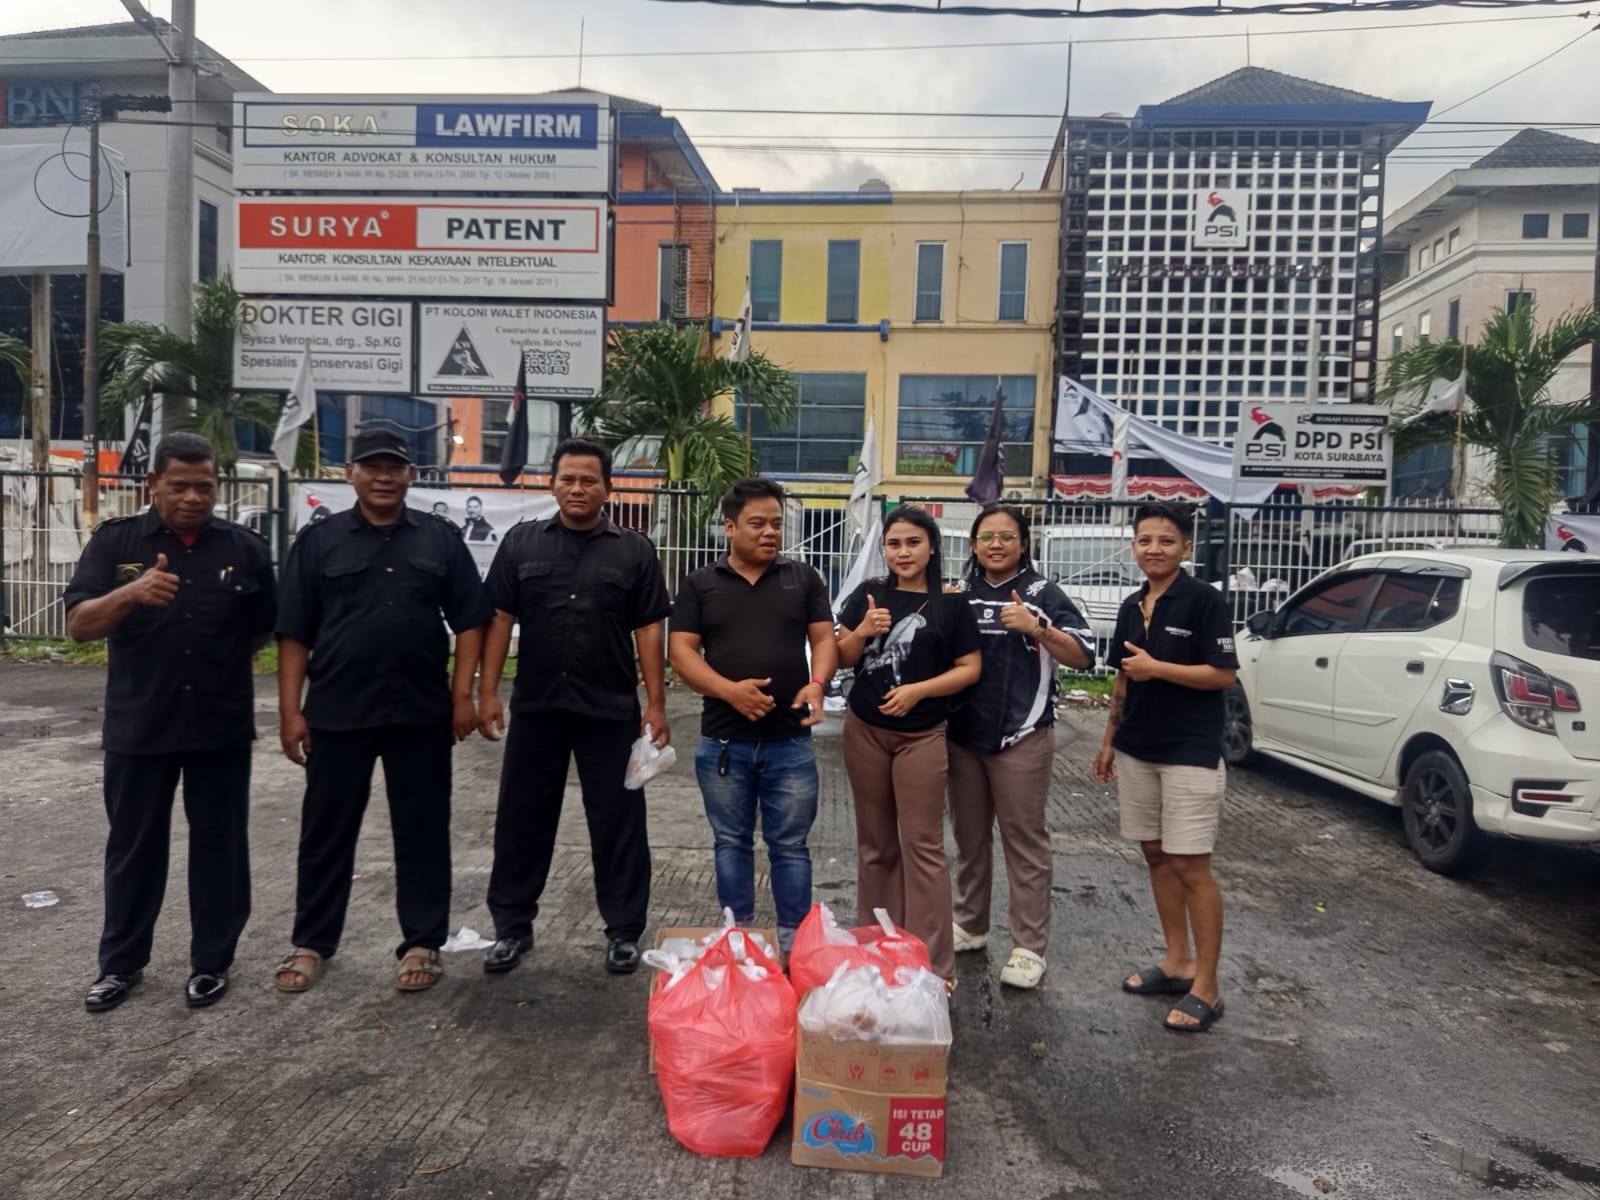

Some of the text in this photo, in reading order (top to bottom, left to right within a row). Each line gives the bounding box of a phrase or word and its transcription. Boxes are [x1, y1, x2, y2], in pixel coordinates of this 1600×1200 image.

[434, 113, 581, 138] LAWFIRM
[283, 152, 557, 165] KANTOR ADVOKAT & KONSULTAN HUKUM
[446, 218, 567, 241] PATENT
[1204, 226, 1238, 237] PSI
[278, 254, 557, 268] KANTOR KONSULTAN KEKAYAAN INTELEKTUAL
[242, 305, 403, 328] DOKTER GIGI
[426, 307, 597, 320] PT KOLONI WALET INDONESIA
[241, 334, 276, 346] Sysca
[241, 355, 403, 373] Spesialis onservasi Gigi
[1295, 431, 1383, 450] DPD PSI
[1245, 443, 1286, 457] PSI
[1294, 452, 1384, 463] KOTA SURABAYA
[893, 1109, 944, 1120] ISI TETAP
[811, 1116, 865, 1143] Club
[899, 1122, 932, 1141] 48
[901, 1142, 931, 1152] CUP
